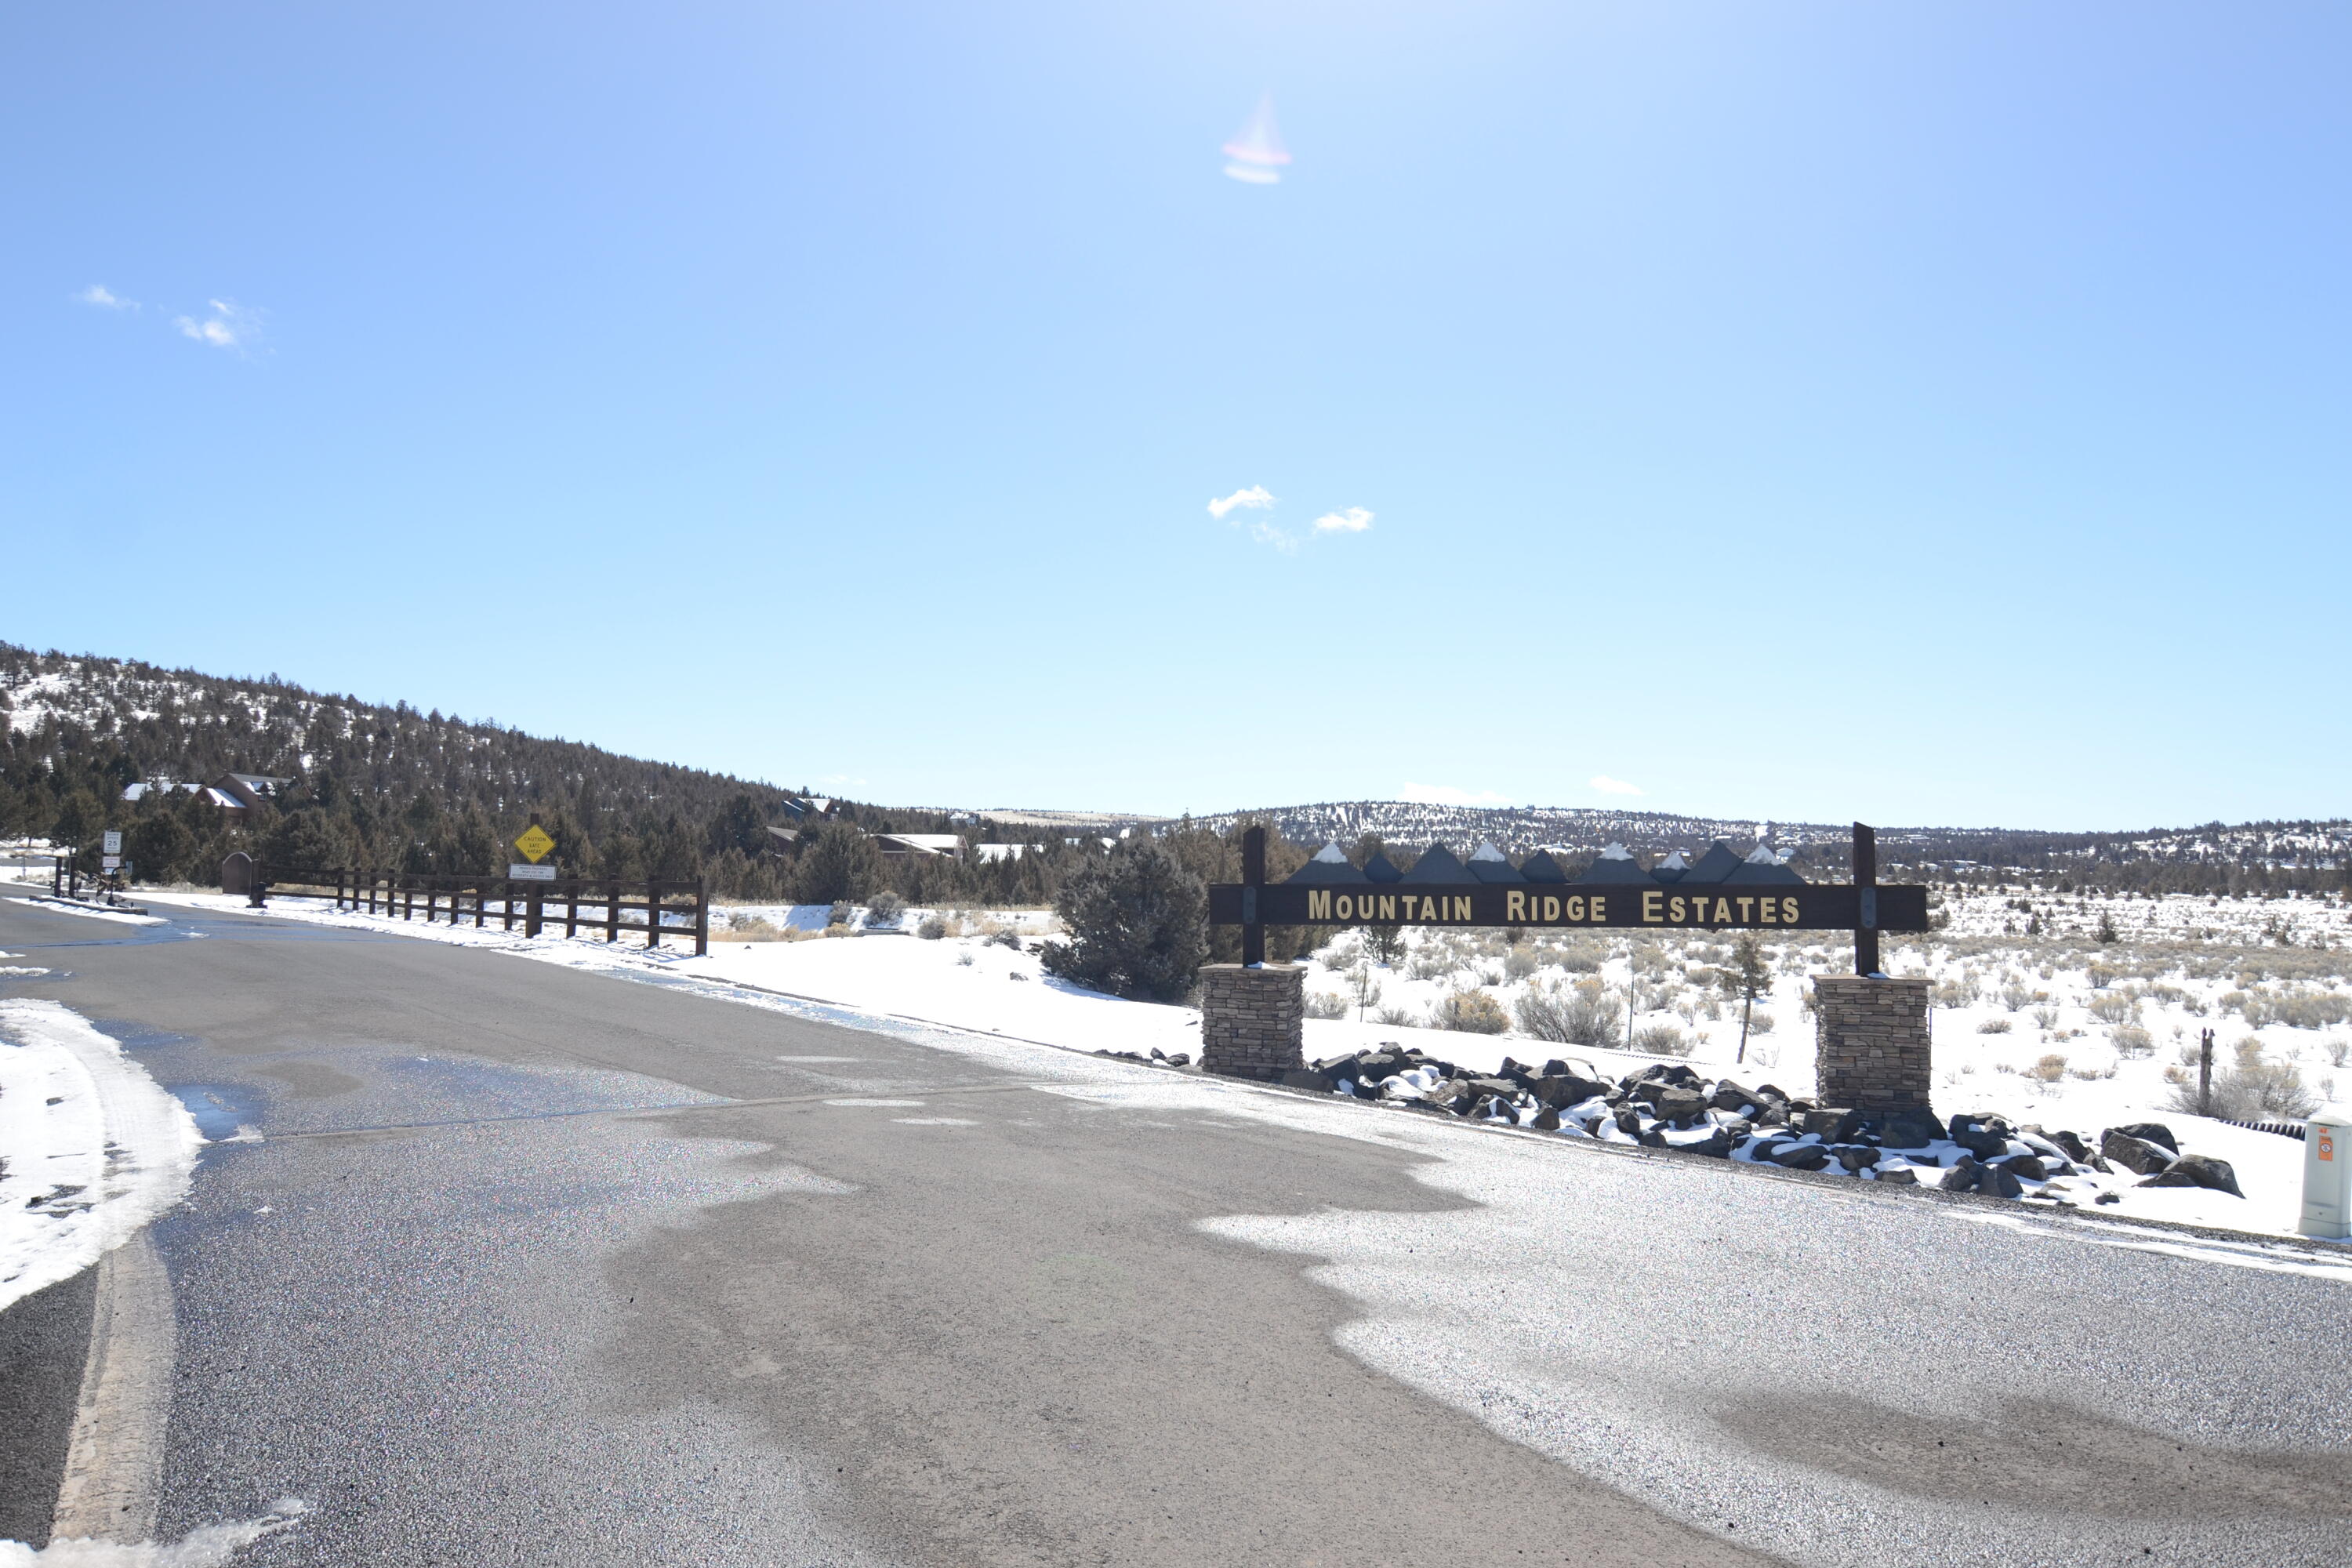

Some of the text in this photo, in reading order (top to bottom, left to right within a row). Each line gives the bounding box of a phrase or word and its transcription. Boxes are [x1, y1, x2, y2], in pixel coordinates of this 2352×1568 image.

[1308, 890, 1799, 924] MOUNTAIN RIDGE ESTATES
